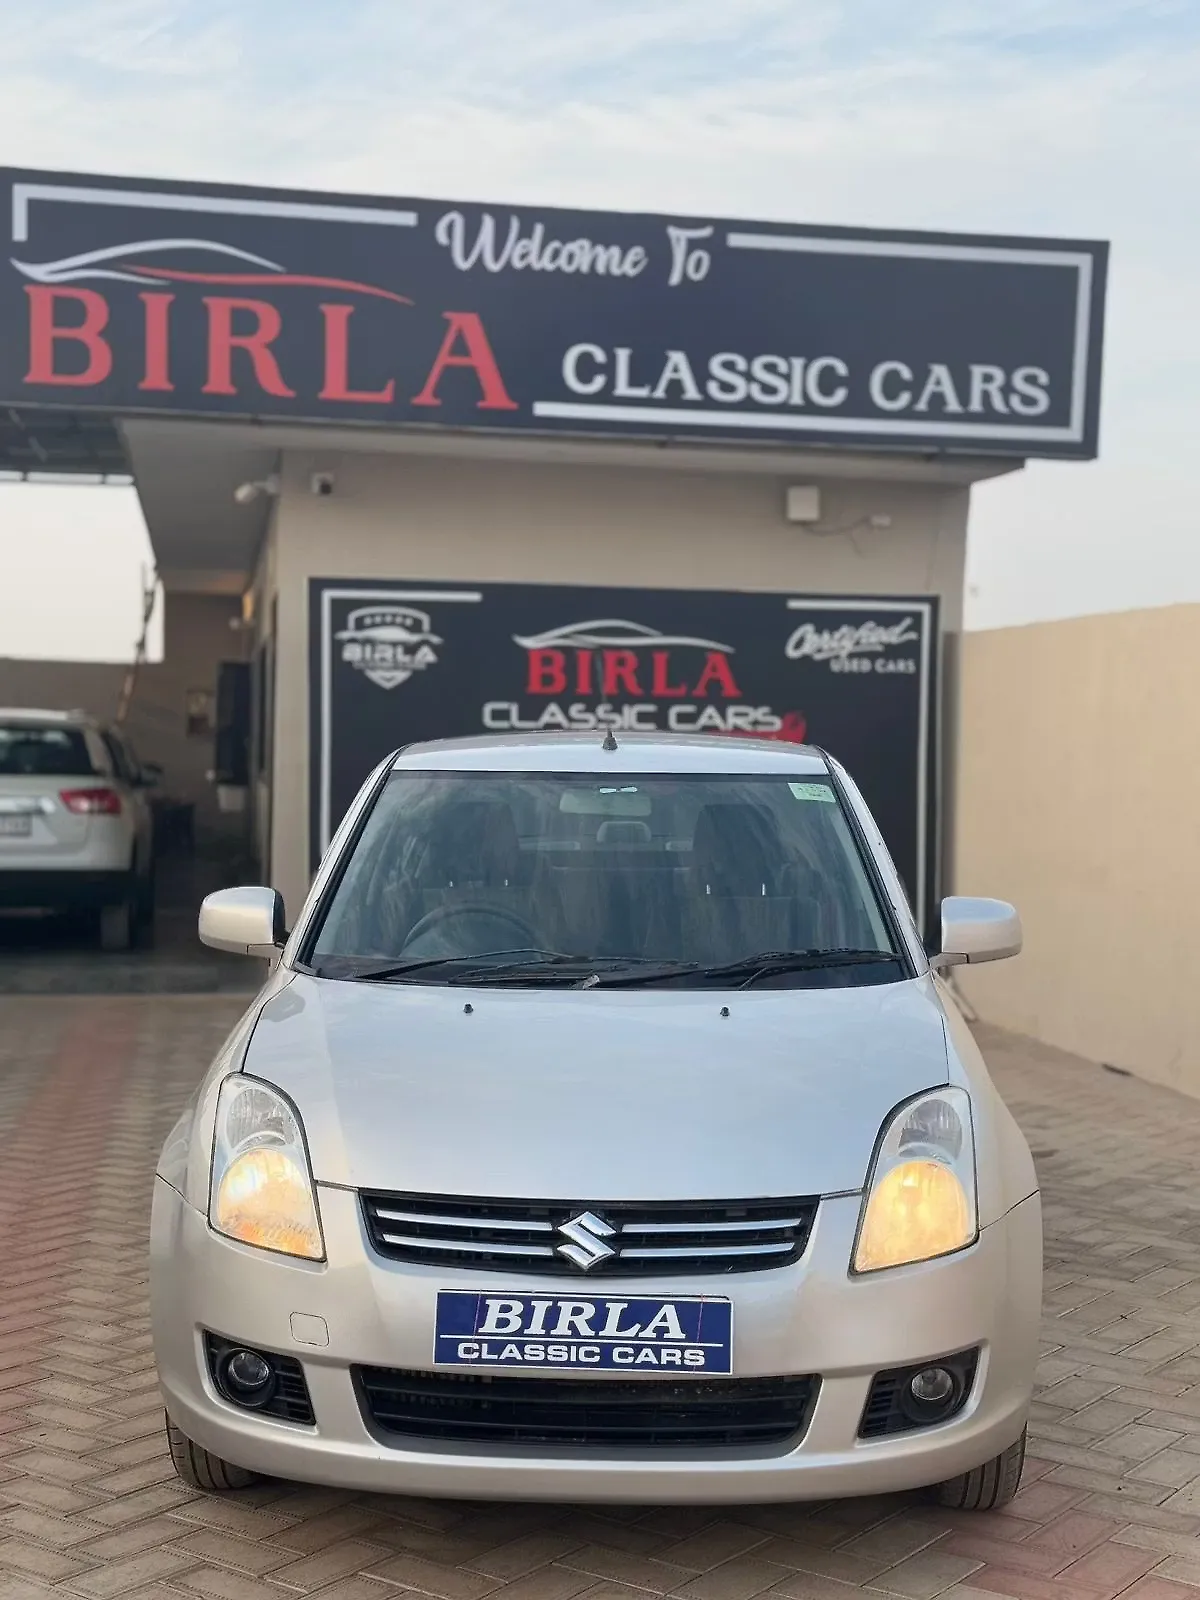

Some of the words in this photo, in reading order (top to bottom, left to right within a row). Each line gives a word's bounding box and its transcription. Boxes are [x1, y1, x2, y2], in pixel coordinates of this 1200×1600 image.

[435, 211, 647, 279] Welcome
[666, 226, 714, 286] To
[23, 284, 519, 410] BIRLA
[562, 343, 849, 407] CLASSIC
[869, 361, 1050, 415] CARS
[342, 641, 438, 664] BIRLA
[526, 648, 741, 697] BIRLA
[830, 658, 871, 673] USED
[874, 658, 916, 674] CARS
[482, 701, 657, 731] CLASSIC
[668, 704, 782, 732] CARS
[478, 1299, 686, 1339] BIRLA
[457, 1342, 600, 1363] CLASSIC
[612, 1346, 705, 1366] CARS
